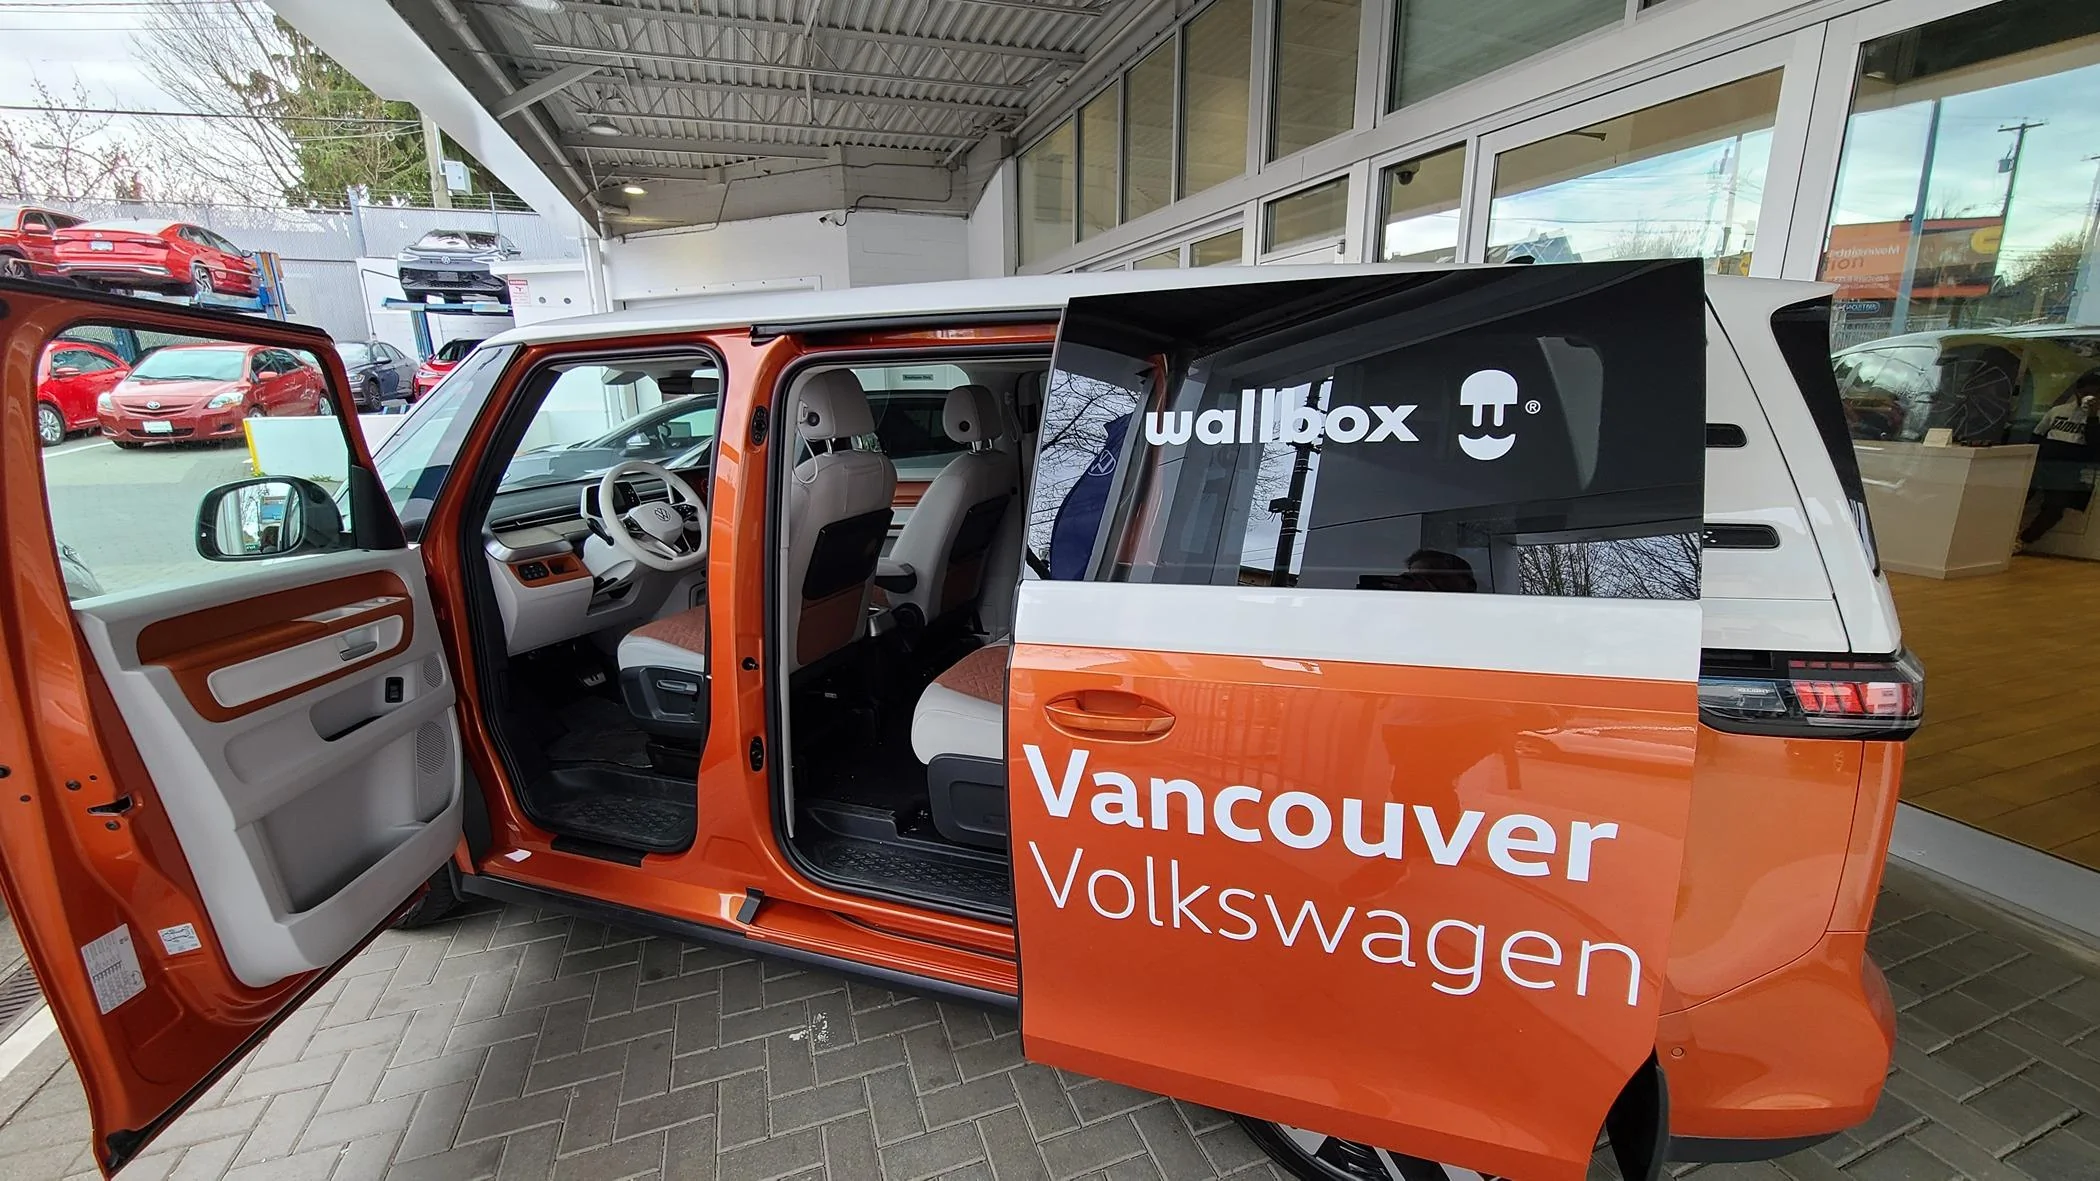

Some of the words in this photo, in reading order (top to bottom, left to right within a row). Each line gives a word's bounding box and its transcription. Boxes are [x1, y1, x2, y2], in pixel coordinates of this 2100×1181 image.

[1145, 387, 1419, 446] wallbox
[1022, 743, 1619, 882] Vancouver
[1028, 840, 1643, 1007] Volkswagen
